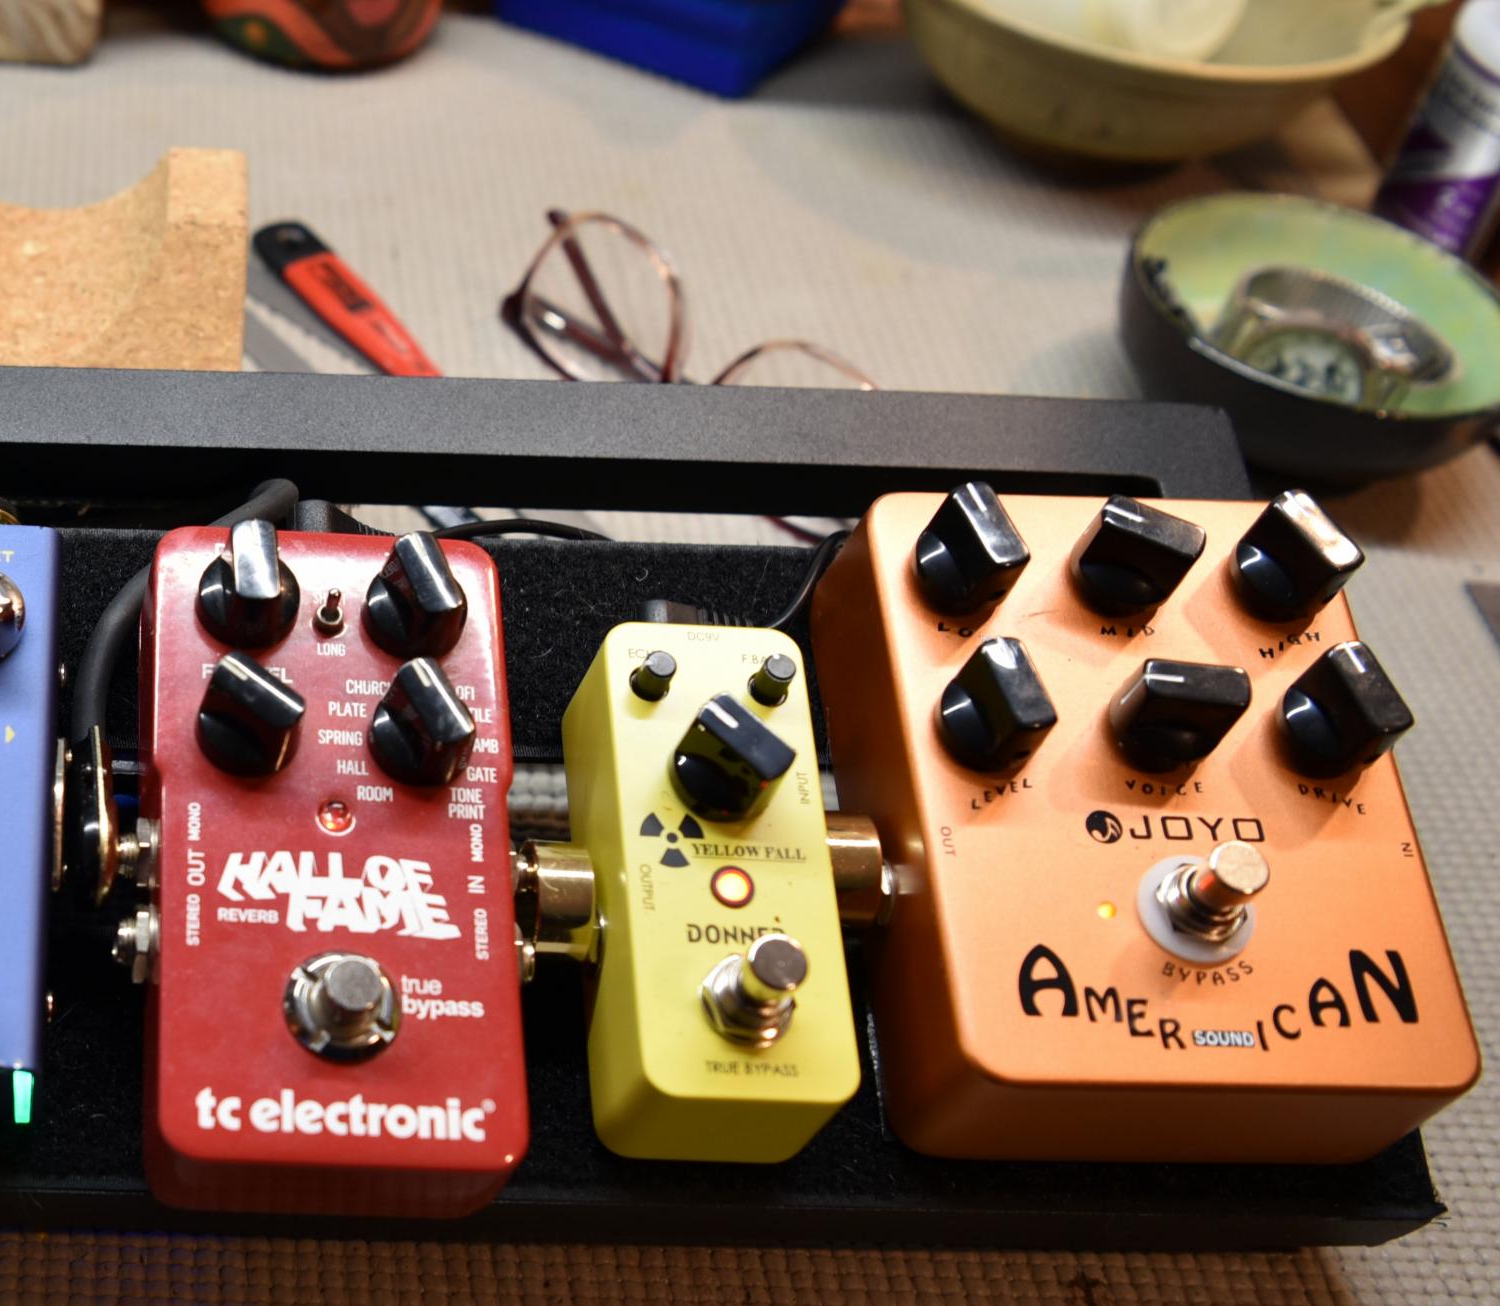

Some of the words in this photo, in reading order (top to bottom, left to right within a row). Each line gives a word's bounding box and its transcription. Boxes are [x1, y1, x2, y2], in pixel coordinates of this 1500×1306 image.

[1100, 625, 1155, 638] MID
[316, 643, 346, 656] LONG
[1259, 631, 1321, 659] HIGH
[346, 679, 391, 695] CHURC
[455, 685, 475, 701] OFI
[328, 702, 367, 718] PLATE
[318, 729, 363, 746] SPRING
[473, 739, 499, 754] AMB
[337, 760, 369, 776] HALL
[466, 767, 497, 783] GATE
[357, 786, 393, 801] ROOM
[450, 787, 483, 804] TONE
[796, 771, 810, 804] INPUT
[971, 778, 1033, 810] LEVEL
[1125, 780, 1204, 796] VOICE
[1298, 783, 1367, 815] DRIVE
[187, 802, 201, 841] MONO
[448, 804, 486, 820] PRINT
[1129, 815, 1266, 842] JOYO
[469, 823, 483, 862] MONO
[691, 843, 760, 859] YELLOW
[765, 845, 807, 860] FALL
[940, 826, 956, 858] OUT
[186, 849, 205, 887] OUT
[217, 850, 365, 901] HALL
[362, 854, 435, 895] OF
[467, 875, 486, 894] IN
[640, 863, 656, 912] OUTPUT
[186, 893, 200, 945] STEREO
[217, 907, 280, 924] REVERB
[286, 884, 462, 940] FAME
[473, 908, 490, 960] STEREO
[1162, 960, 1253, 986] BYPASS
[401, 975, 442, 995] true
[401, 995, 485, 1020] bypass
[1192, 1030, 1256, 1047] SOUND
[705, 1060, 739, 1076] TRUE
[743, 1061, 799, 1077] BYPASS
[195, 1086, 242, 1131] tc
